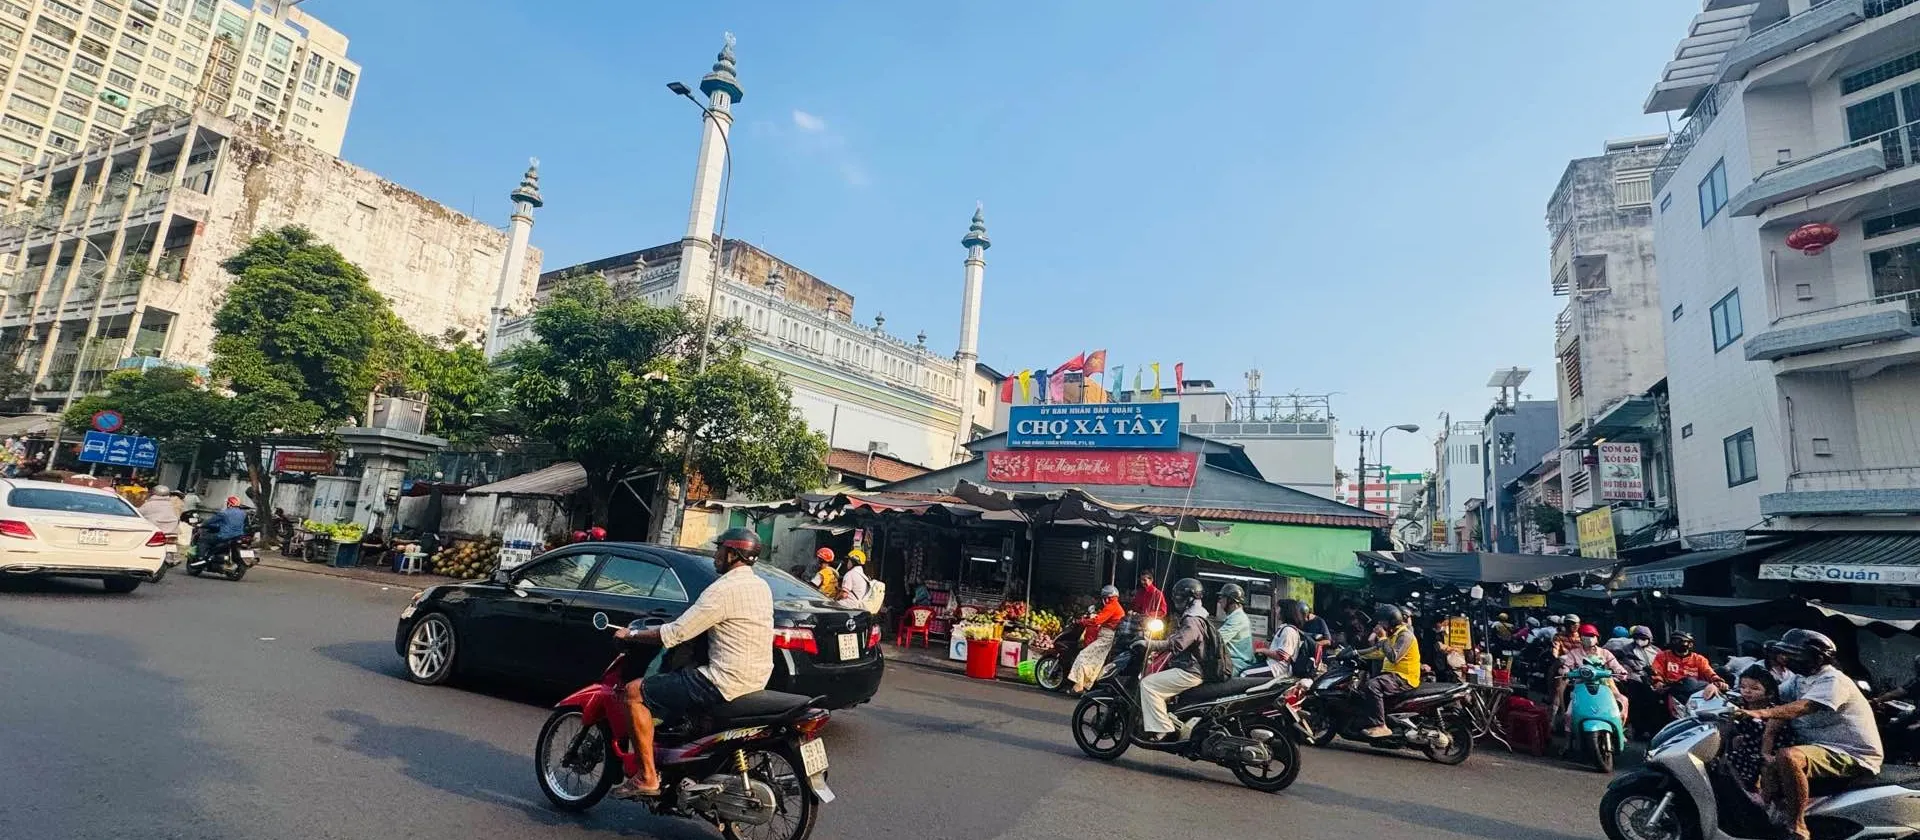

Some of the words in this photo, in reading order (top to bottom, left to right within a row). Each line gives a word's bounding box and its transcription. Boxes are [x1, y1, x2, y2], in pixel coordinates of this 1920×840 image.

[1093, 406, 1109, 414] DÂN
[1111, 406, 1133, 415] QUẬN
[1016, 419, 1069, 439] CHỢ
[1072, 415, 1109, 435] XÃ
[1113, 413, 1168, 435] TÂY
[1624, 444, 1639, 453] GÀ
[1826, 568, 1880, 580] Quán
